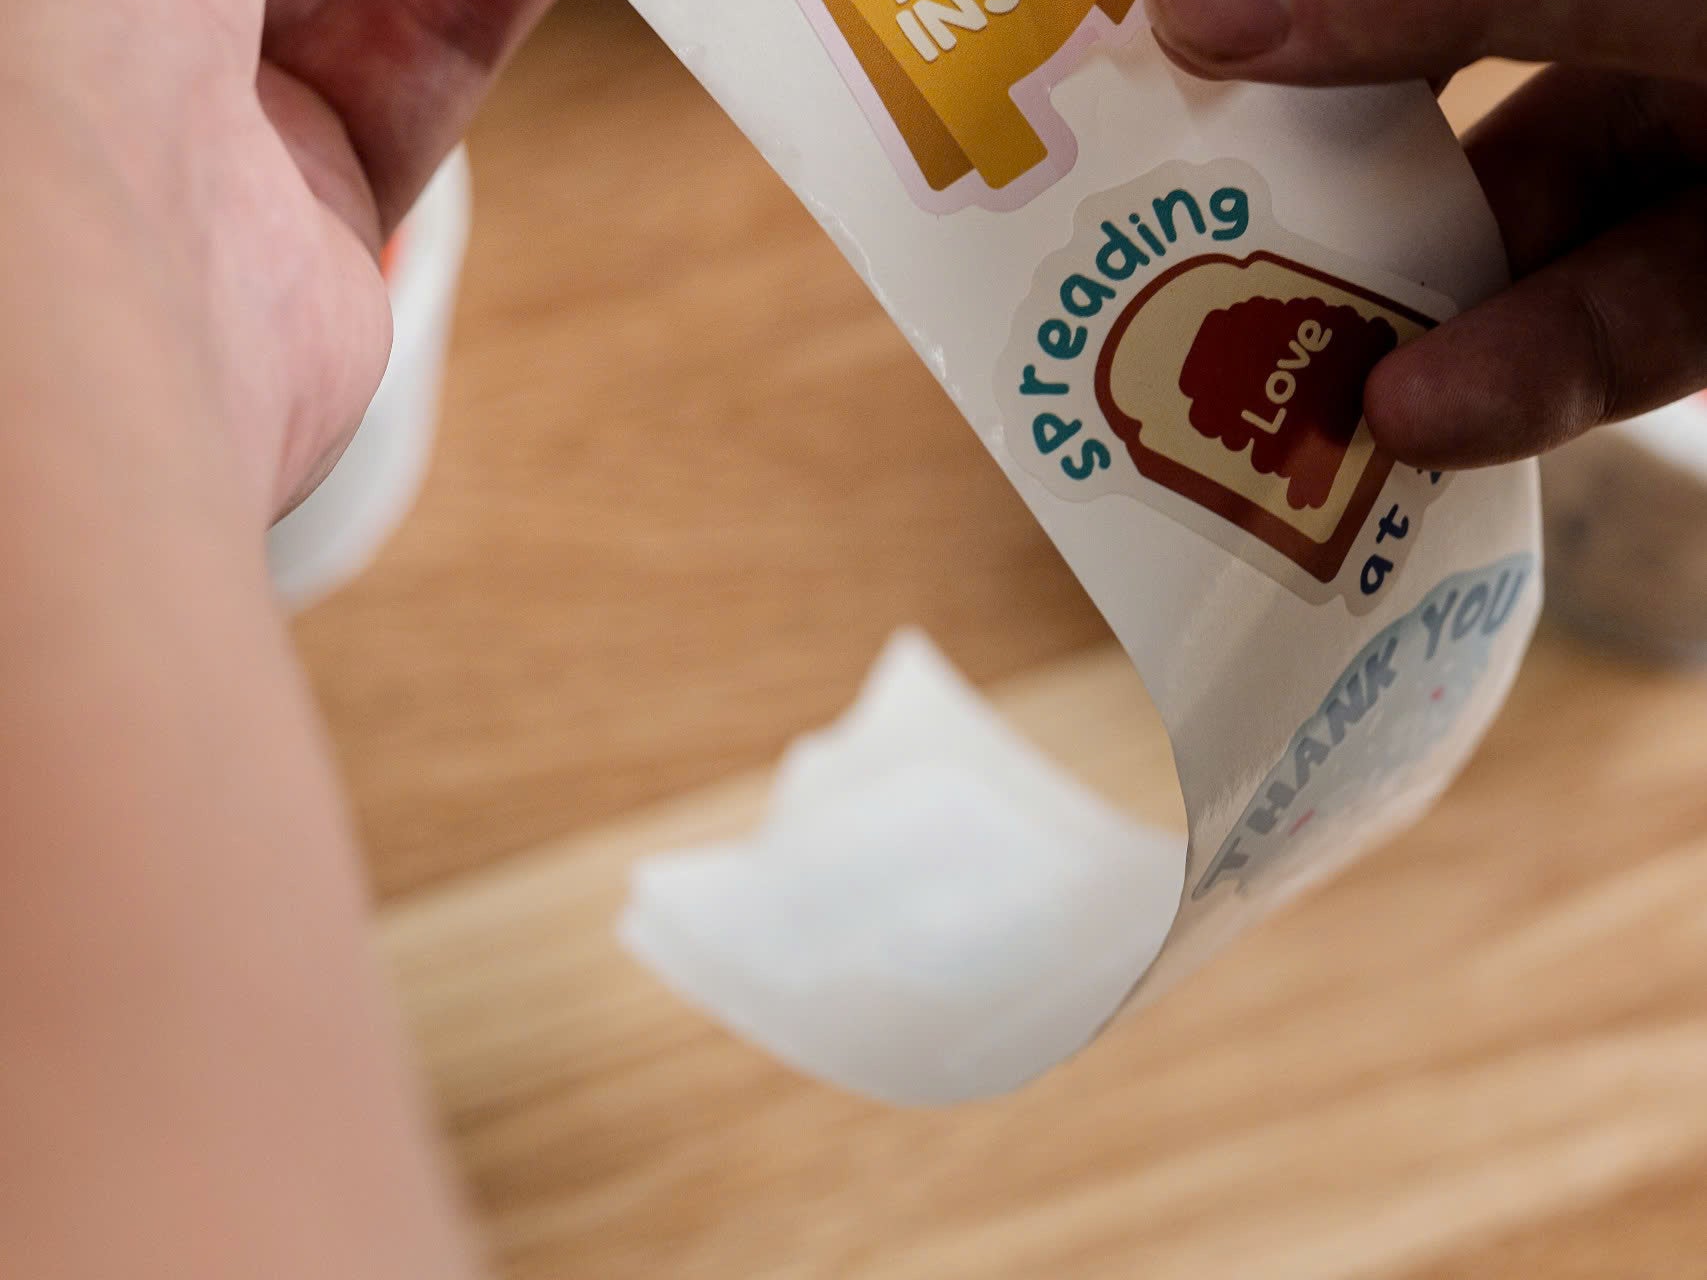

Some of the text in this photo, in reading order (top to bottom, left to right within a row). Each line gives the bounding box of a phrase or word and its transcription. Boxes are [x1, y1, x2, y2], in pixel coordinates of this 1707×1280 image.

[1019, 187, 1249, 481] spreading
[1240, 319, 1333, 435] Love
[1360, 504, 1410, 595] at
[1203, 570, 1526, 889] THANK YOU
